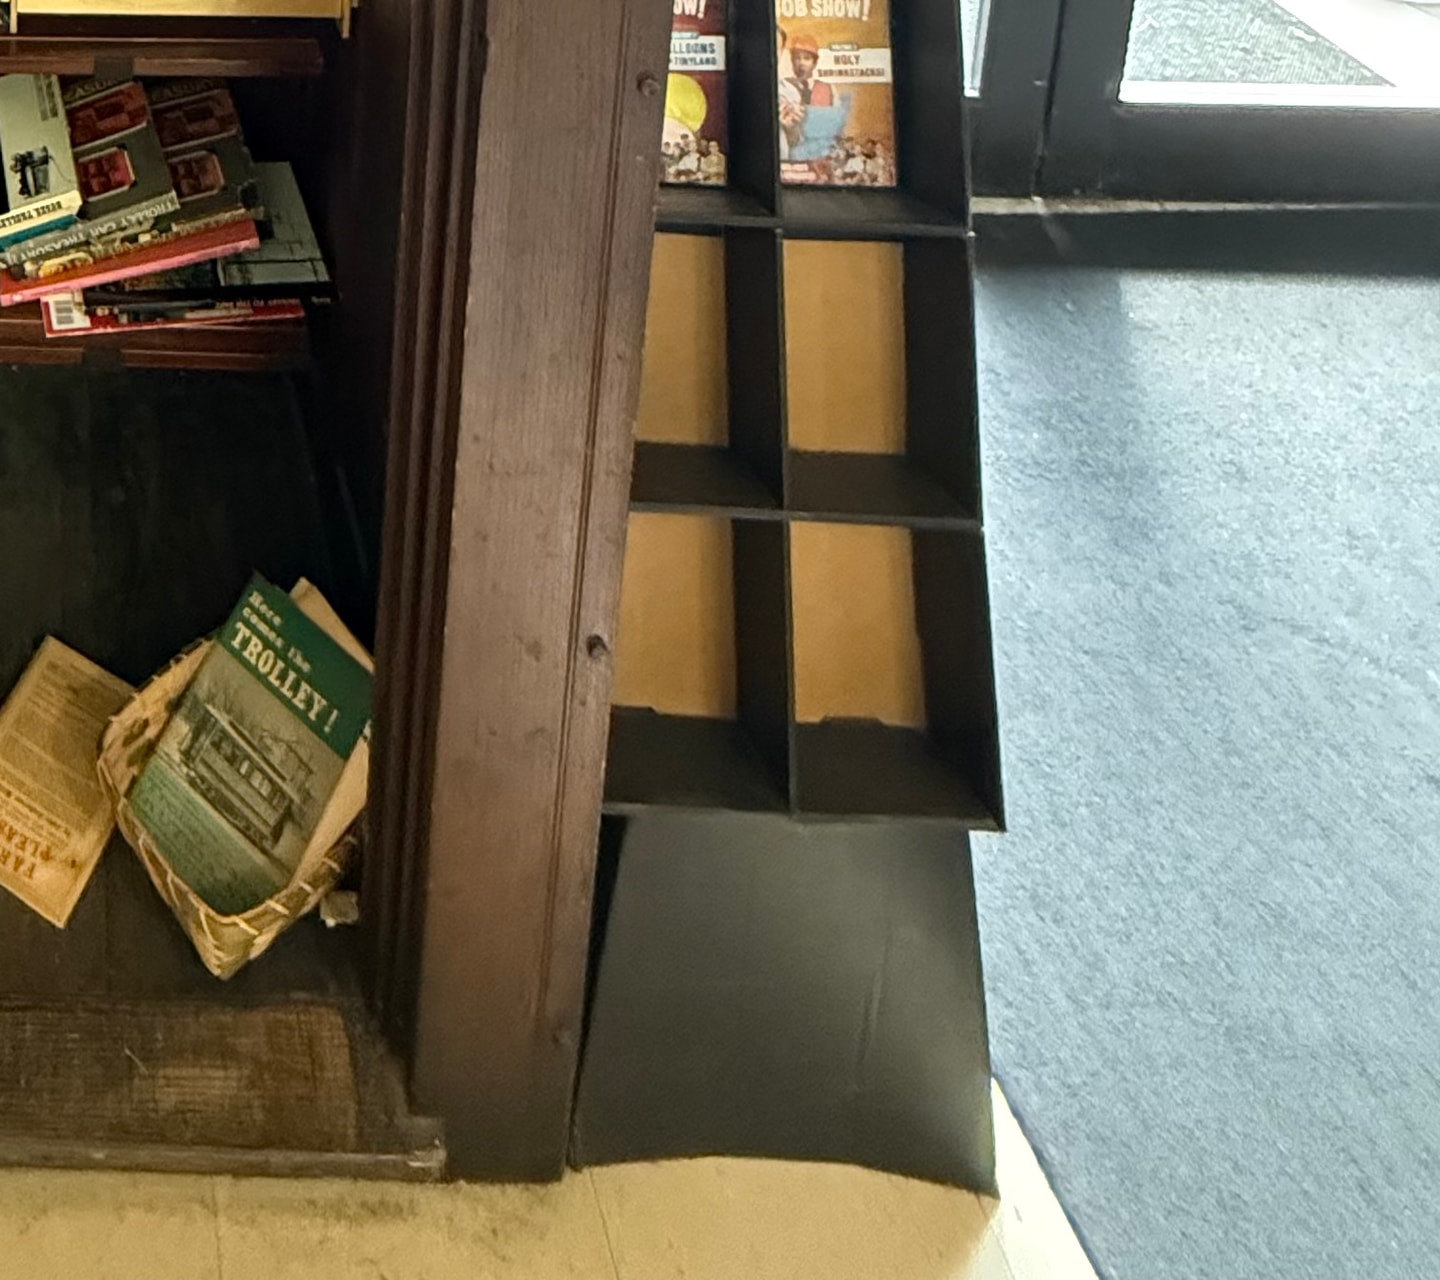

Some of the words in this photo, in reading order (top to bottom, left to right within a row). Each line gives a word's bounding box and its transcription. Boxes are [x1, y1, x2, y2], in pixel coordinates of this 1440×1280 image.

[89, 221, 117, 238] CAR
[248, 591, 282, 627] Here
[287, 646, 313, 673] the
